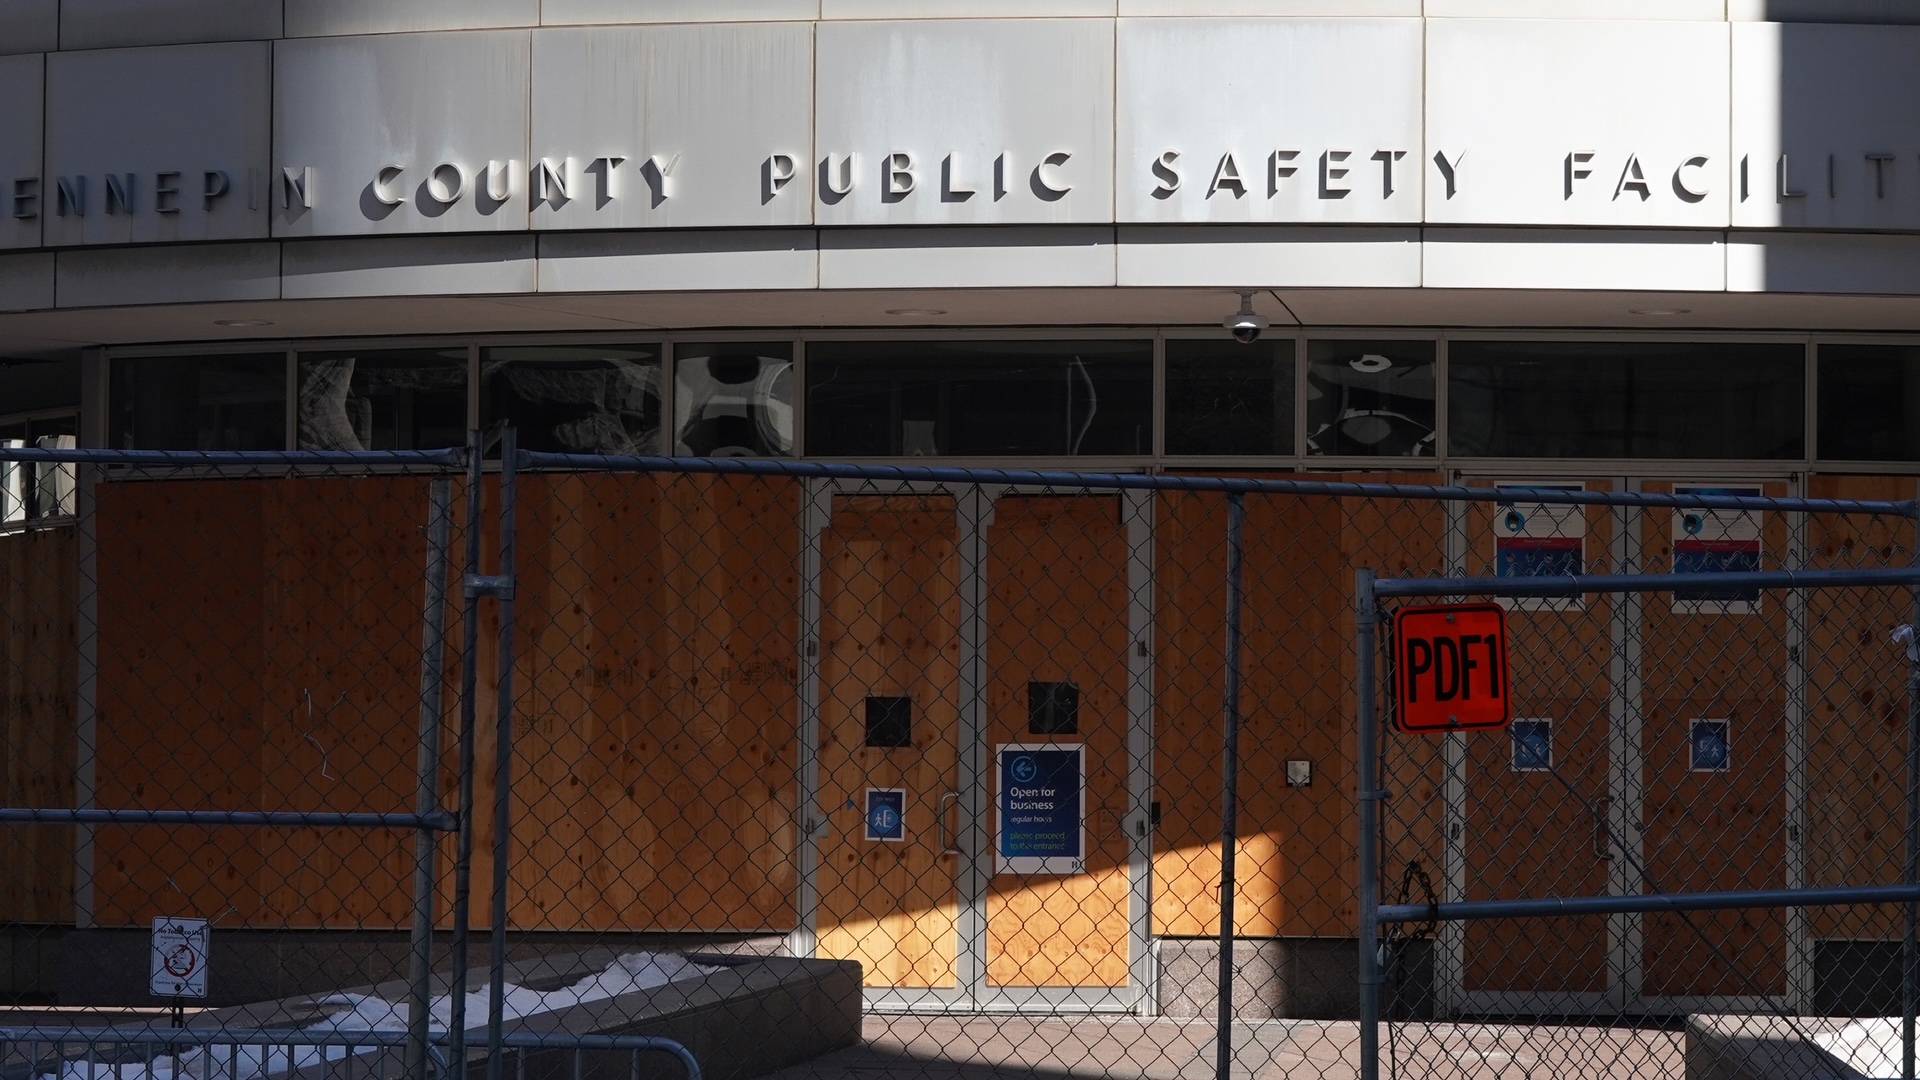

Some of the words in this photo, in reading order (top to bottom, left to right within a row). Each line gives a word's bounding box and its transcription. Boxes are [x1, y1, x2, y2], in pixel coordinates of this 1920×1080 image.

[0, 166, 312, 219] ENNEPIN
[366, 153, 680, 207] COUNTY
[764, 151, 1074, 201] PUBLIC
[1150, 147, 1468, 199] SAFETY
[1564, 150, 1920, 203] FACILIT
[1407, 634, 1499, 703] PDF1
[1010, 787, 1039, 799] Open
[1040, 785, 1055, 798] for
[1010, 800, 1054, 810] business
